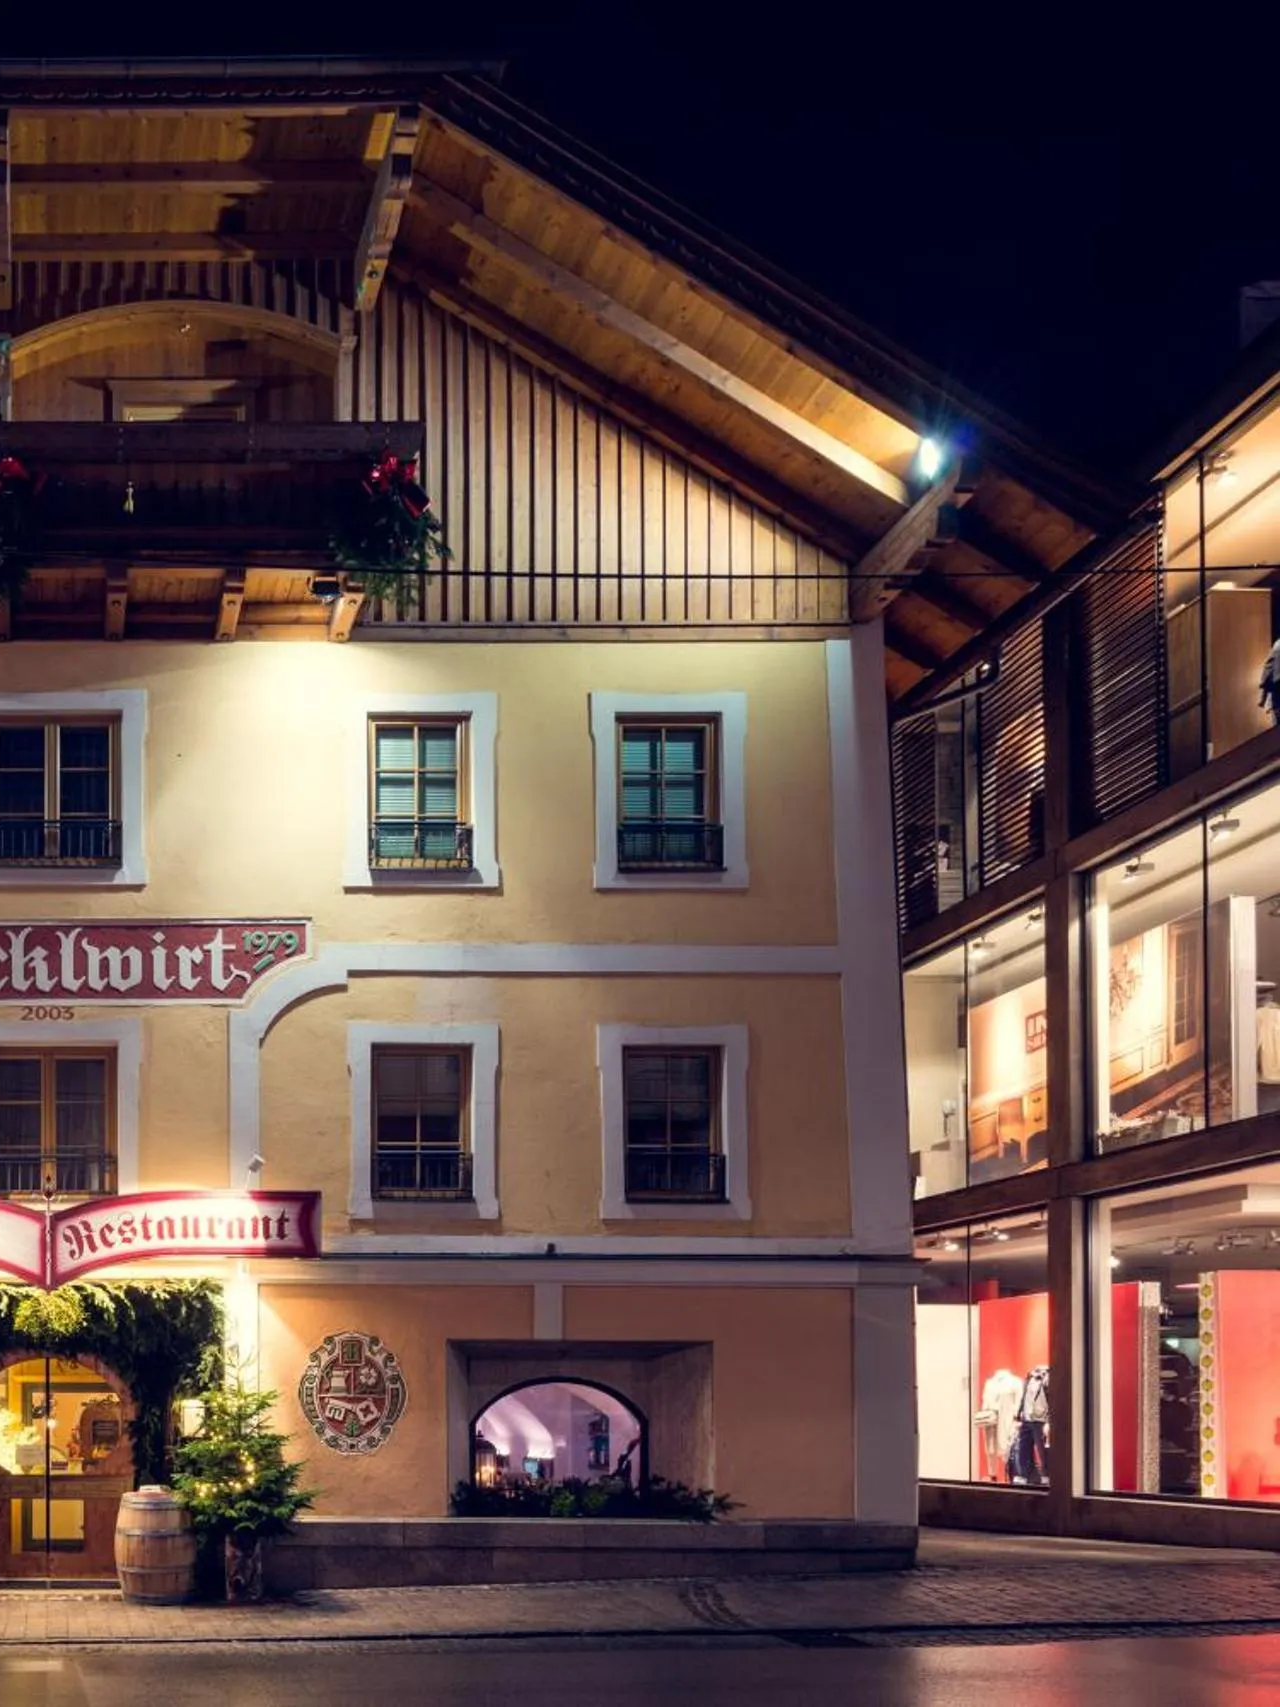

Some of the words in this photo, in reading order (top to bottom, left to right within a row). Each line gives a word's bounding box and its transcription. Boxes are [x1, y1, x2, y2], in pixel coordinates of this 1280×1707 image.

[241, 930, 299, 956] 1979
[20, 1005, 75, 1021] 2003
[62, 1208, 290, 1261] Restaurant
